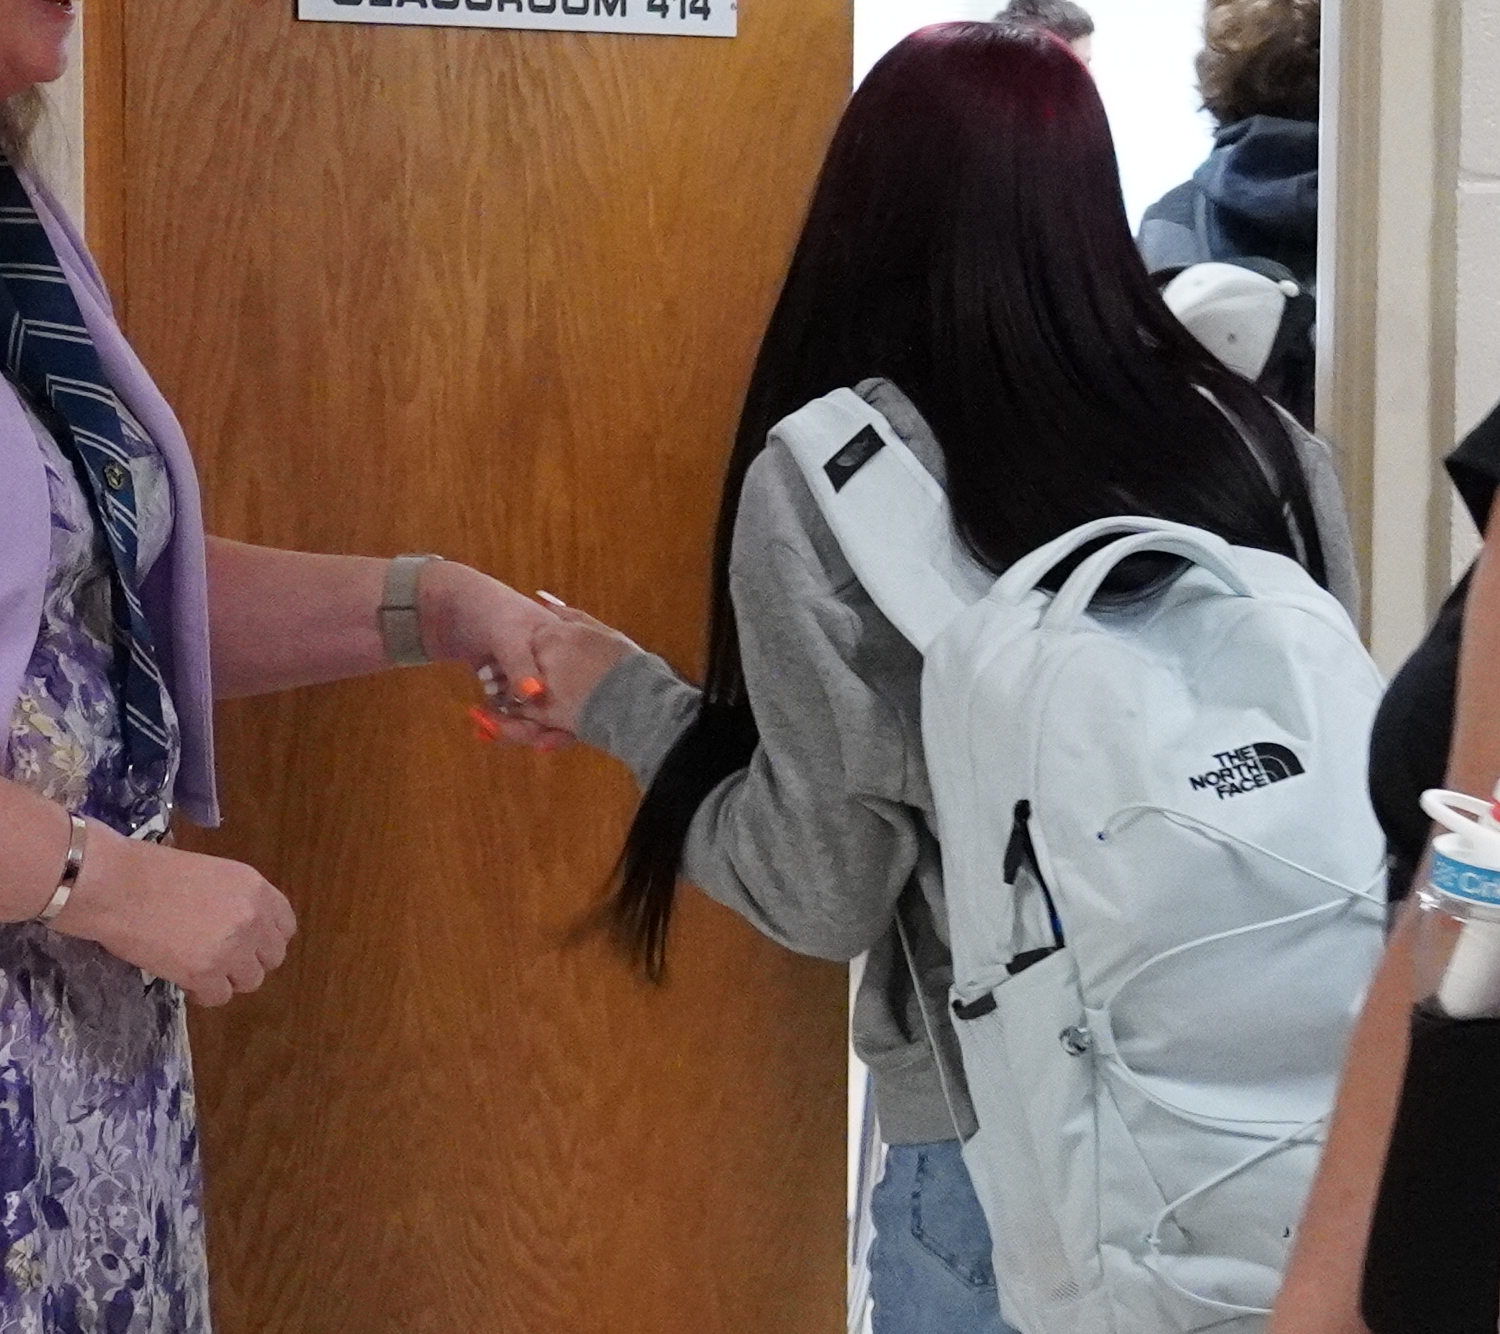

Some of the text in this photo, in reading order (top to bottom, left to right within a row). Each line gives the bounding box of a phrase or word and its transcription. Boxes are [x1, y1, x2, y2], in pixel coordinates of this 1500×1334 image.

[1212, 744, 1255, 768] THE
[1188, 759, 1264, 792] NORTH
[1215, 773, 1270, 801] FACE
